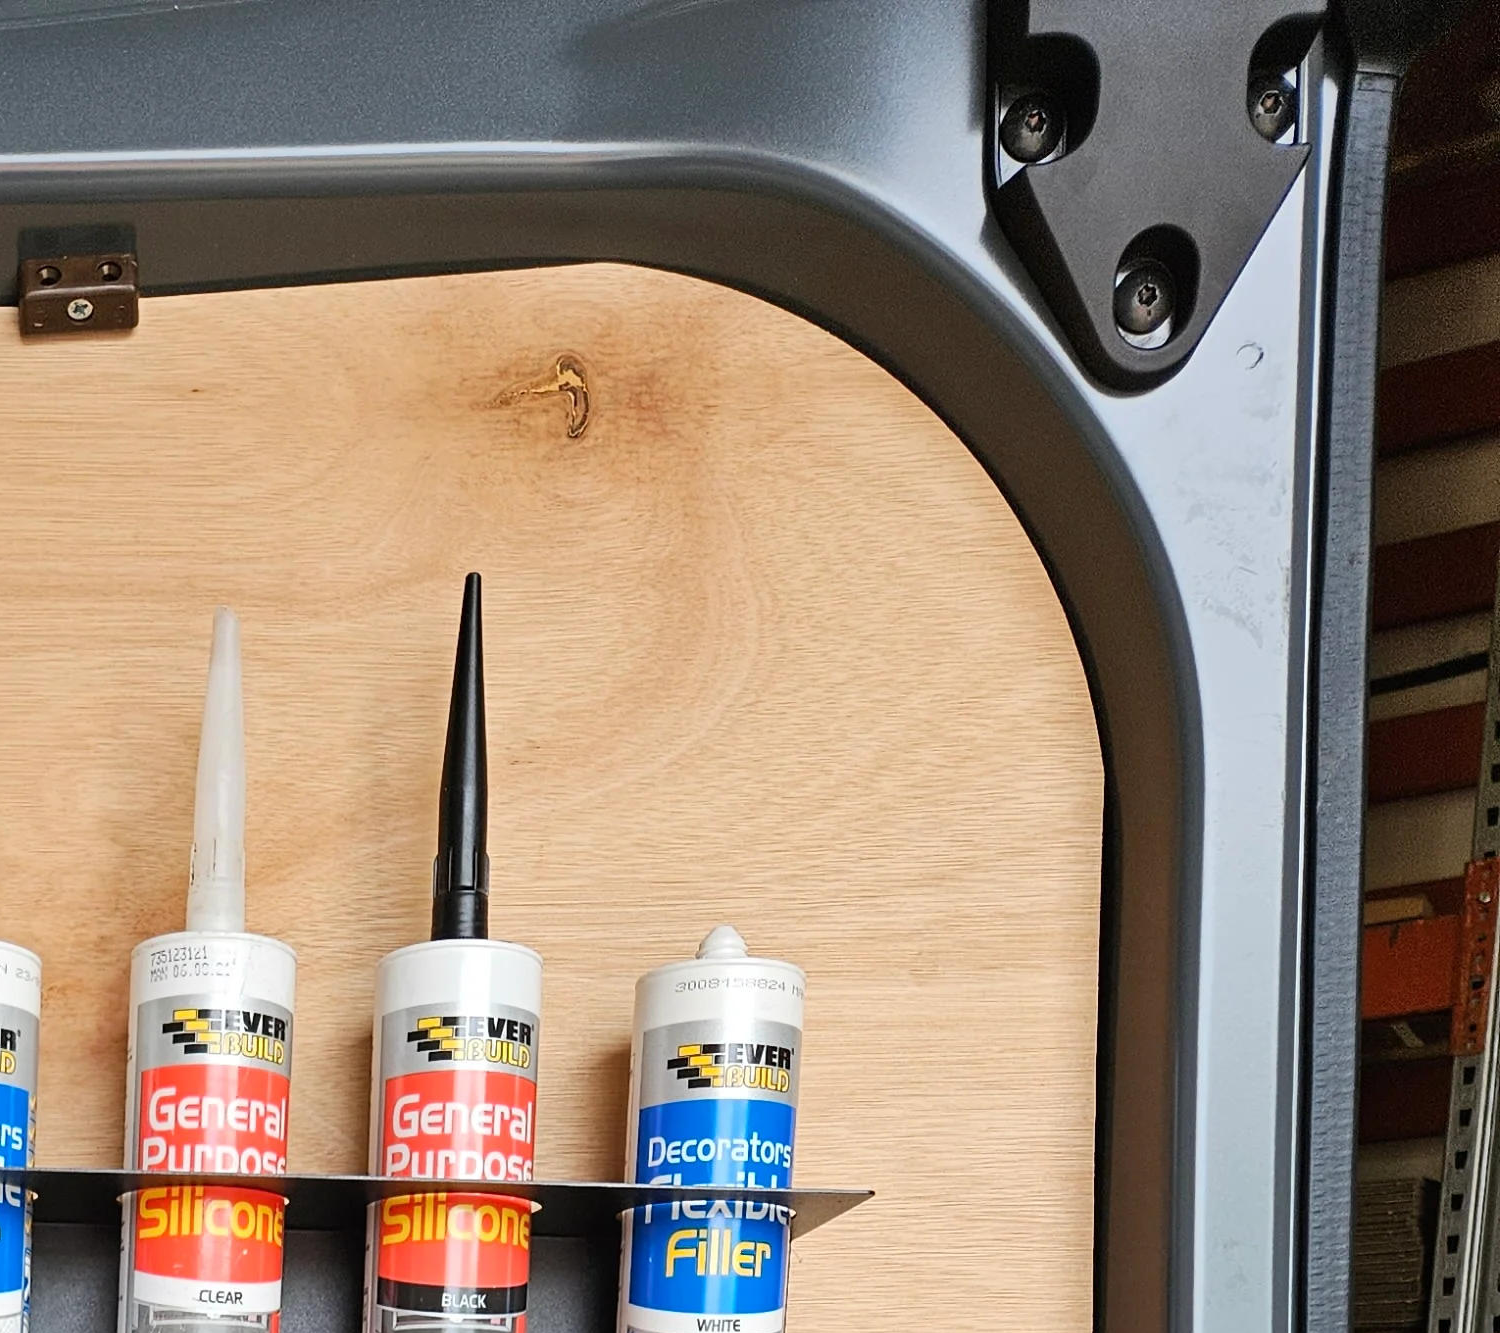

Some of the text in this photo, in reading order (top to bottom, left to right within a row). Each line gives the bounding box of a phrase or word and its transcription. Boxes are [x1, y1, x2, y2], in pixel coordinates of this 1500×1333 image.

[225, 1009, 285, 1041] EVER
[467, 1016, 532, 1046] EVER
[222, 1033, 285, 1066] BUILD
[465, 1039, 531, 1070] BUILD
[728, 1043, 791, 1070] EVER
[725, 1065, 790, 1093] BUILD
[149, 1086, 285, 1142] General
[392, 1093, 532, 1144] General
[647, 1131, 792, 1169] Decorators
[138, 1186, 283, 1248] Silicone
[382, 1192, 531, 1250] Silicone
[665, 1228, 771, 1278] Filler
[199, 1289, 243, 1305] CLEAR
[441, 1292, 487, 1309] BLACK
[697, 1317, 741, 1333] WHITE
